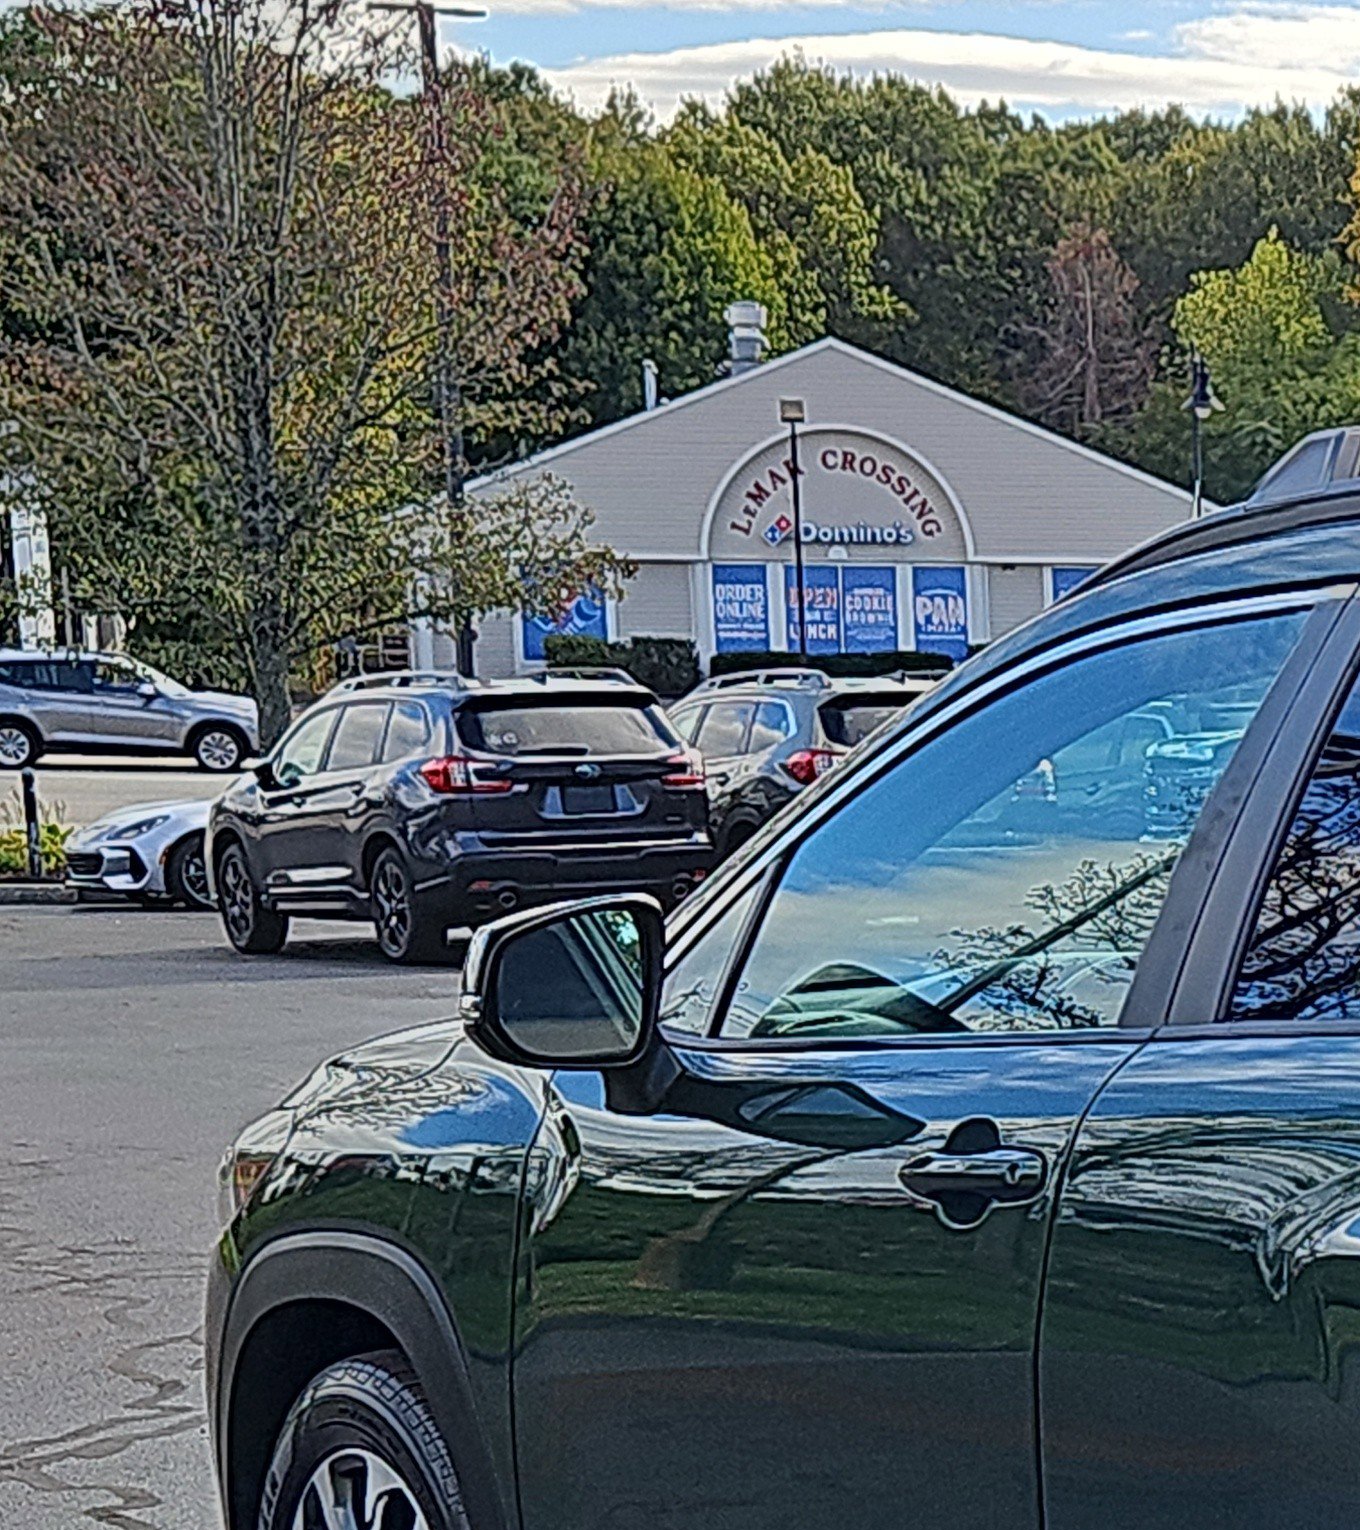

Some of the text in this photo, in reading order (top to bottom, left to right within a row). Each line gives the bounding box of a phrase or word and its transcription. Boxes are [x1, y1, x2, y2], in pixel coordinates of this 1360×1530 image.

[821, 449, 942, 538] CROSSING
[800, 521, 914, 544] Domino's
[715, 584, 765, 601] ORDER
[716, 602, 766, 620] ONLINE
[916, 596, 965, 627] PAN
[789, 623, 837, 640] LNCH
